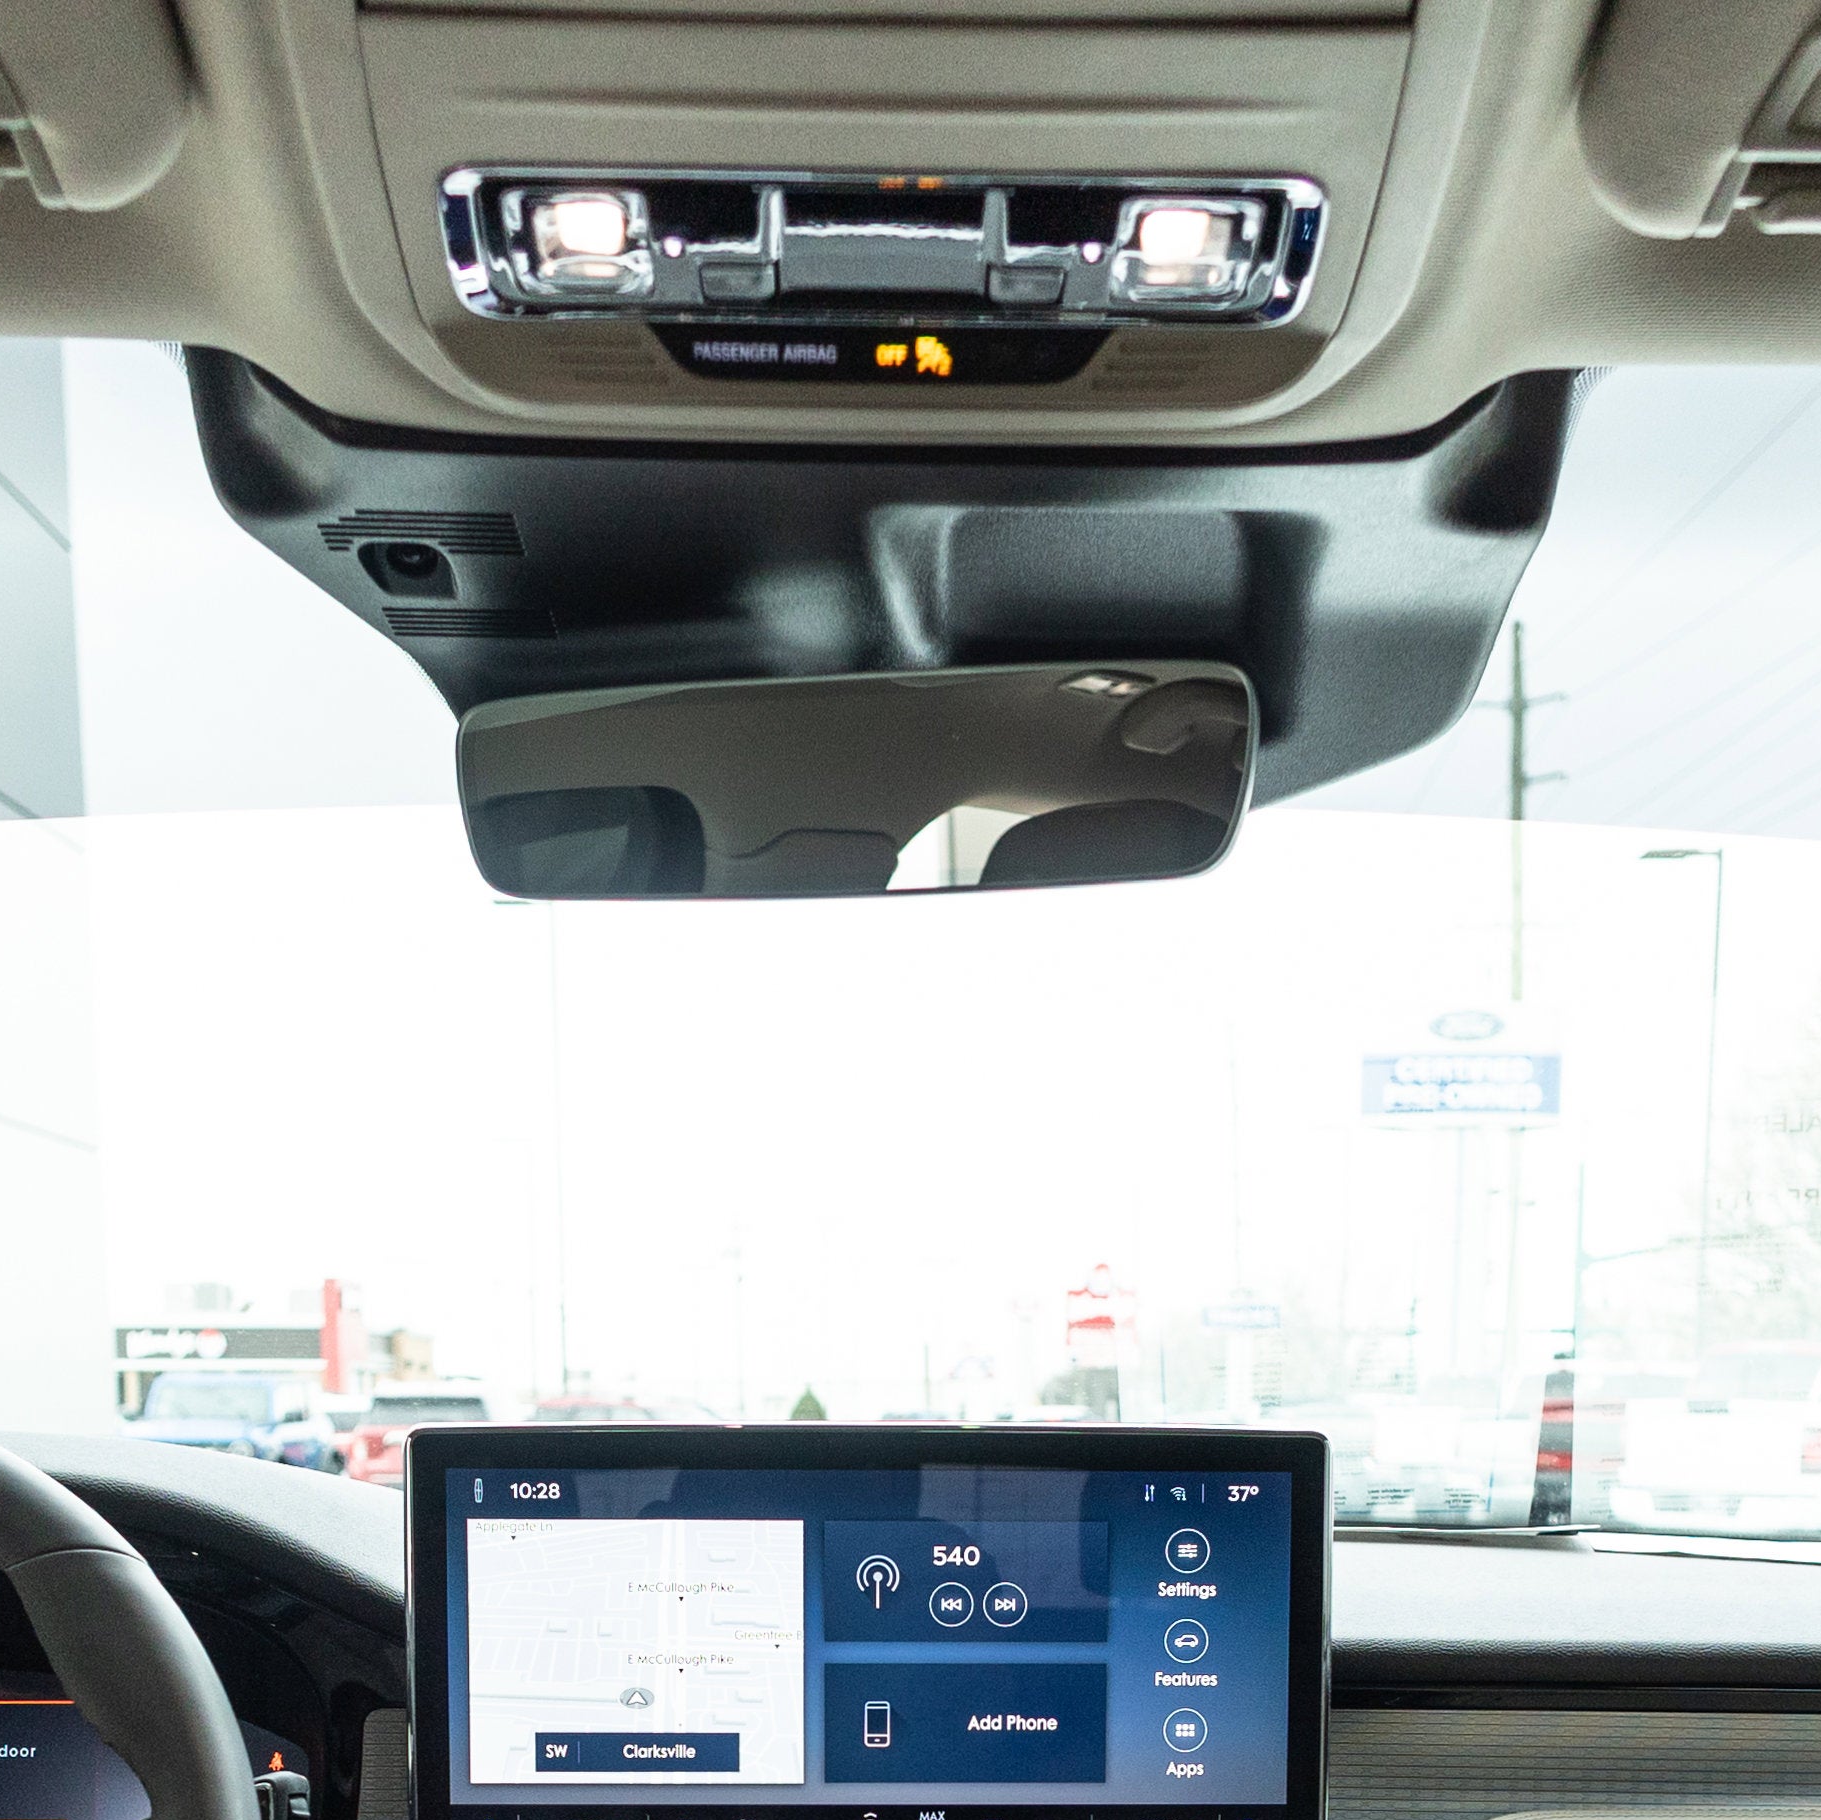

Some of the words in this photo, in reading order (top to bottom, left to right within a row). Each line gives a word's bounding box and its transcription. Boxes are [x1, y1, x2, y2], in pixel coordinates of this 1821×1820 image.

[693, 341, 779, 362] PASSENGER
[783, 345, 837, 364] AIRBAG
[509, 1482, 561, 1500] 10:28
[475, 1522, 537, 1533] Applegate
[540, 1522, 553, 1532] Ln
[932, 1545, 981, 1567] 540
[637, 1582, 708, 1595] McCullough
[710, 1582, 735, 1593] Pike
[1157, 1582, 1218, 1599] Settings
[734, 1629, 793, 1641] Greentree
[637, 1654, 708, 1667] McCullough
[710, 1654, 735, 1665] Pike
[1154, 1671, 1218, 1687] Features
[967, 1714, 1004, 1732] Add
[1006, 1714, 1059, 1732] Phone
[545, 1744, 569, 1758] SW
[622, 1743, 697, 1759] Clarksville
[1165, 1761, 1205, 1777] Apps
